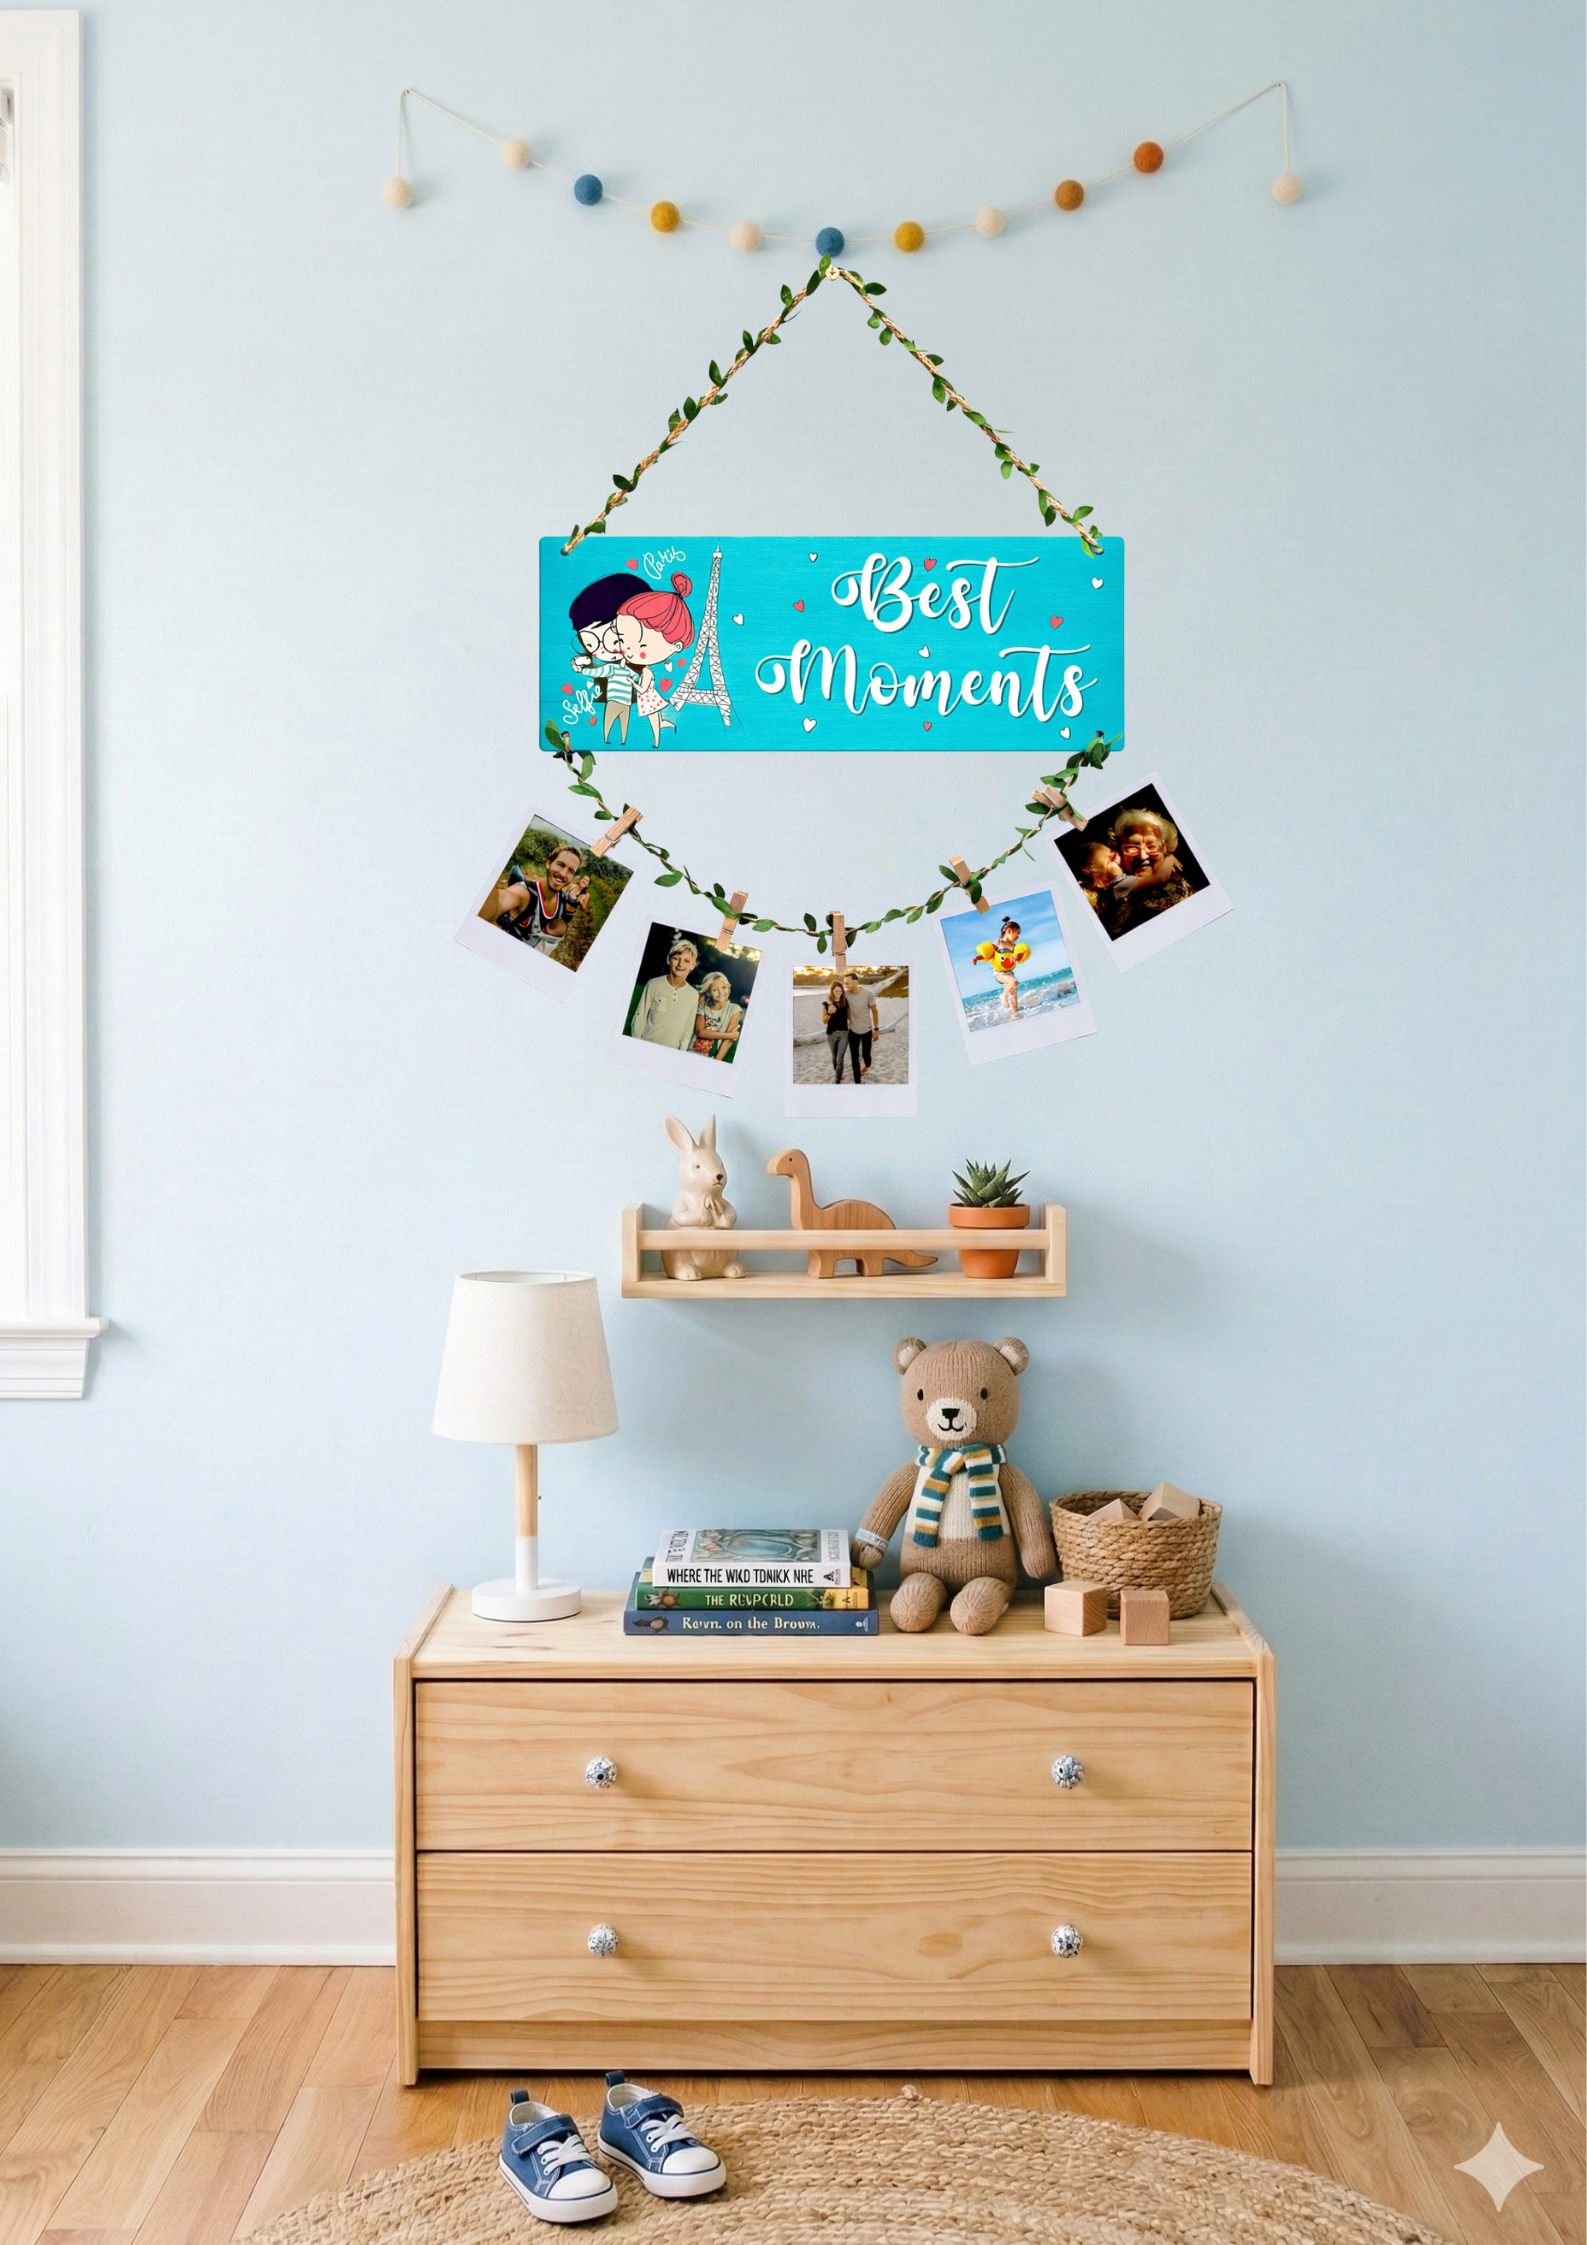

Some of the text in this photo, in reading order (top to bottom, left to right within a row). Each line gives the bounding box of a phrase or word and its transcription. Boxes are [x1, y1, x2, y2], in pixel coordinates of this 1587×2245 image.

[643, 546, 686, 579] Paris
[831, 552, 1039, 634] Best
[755, 640, 1098, 722] Moments
[562, 685, 603, 725] Selfie
[667, 1568, 701, 1583] WHERE
[704, 1568, 723, 1583] THE
[705, 1594, 724, 1606] THE
[726, 1620, 743, 1629] on
[747, 1616, 768, 1629] the
